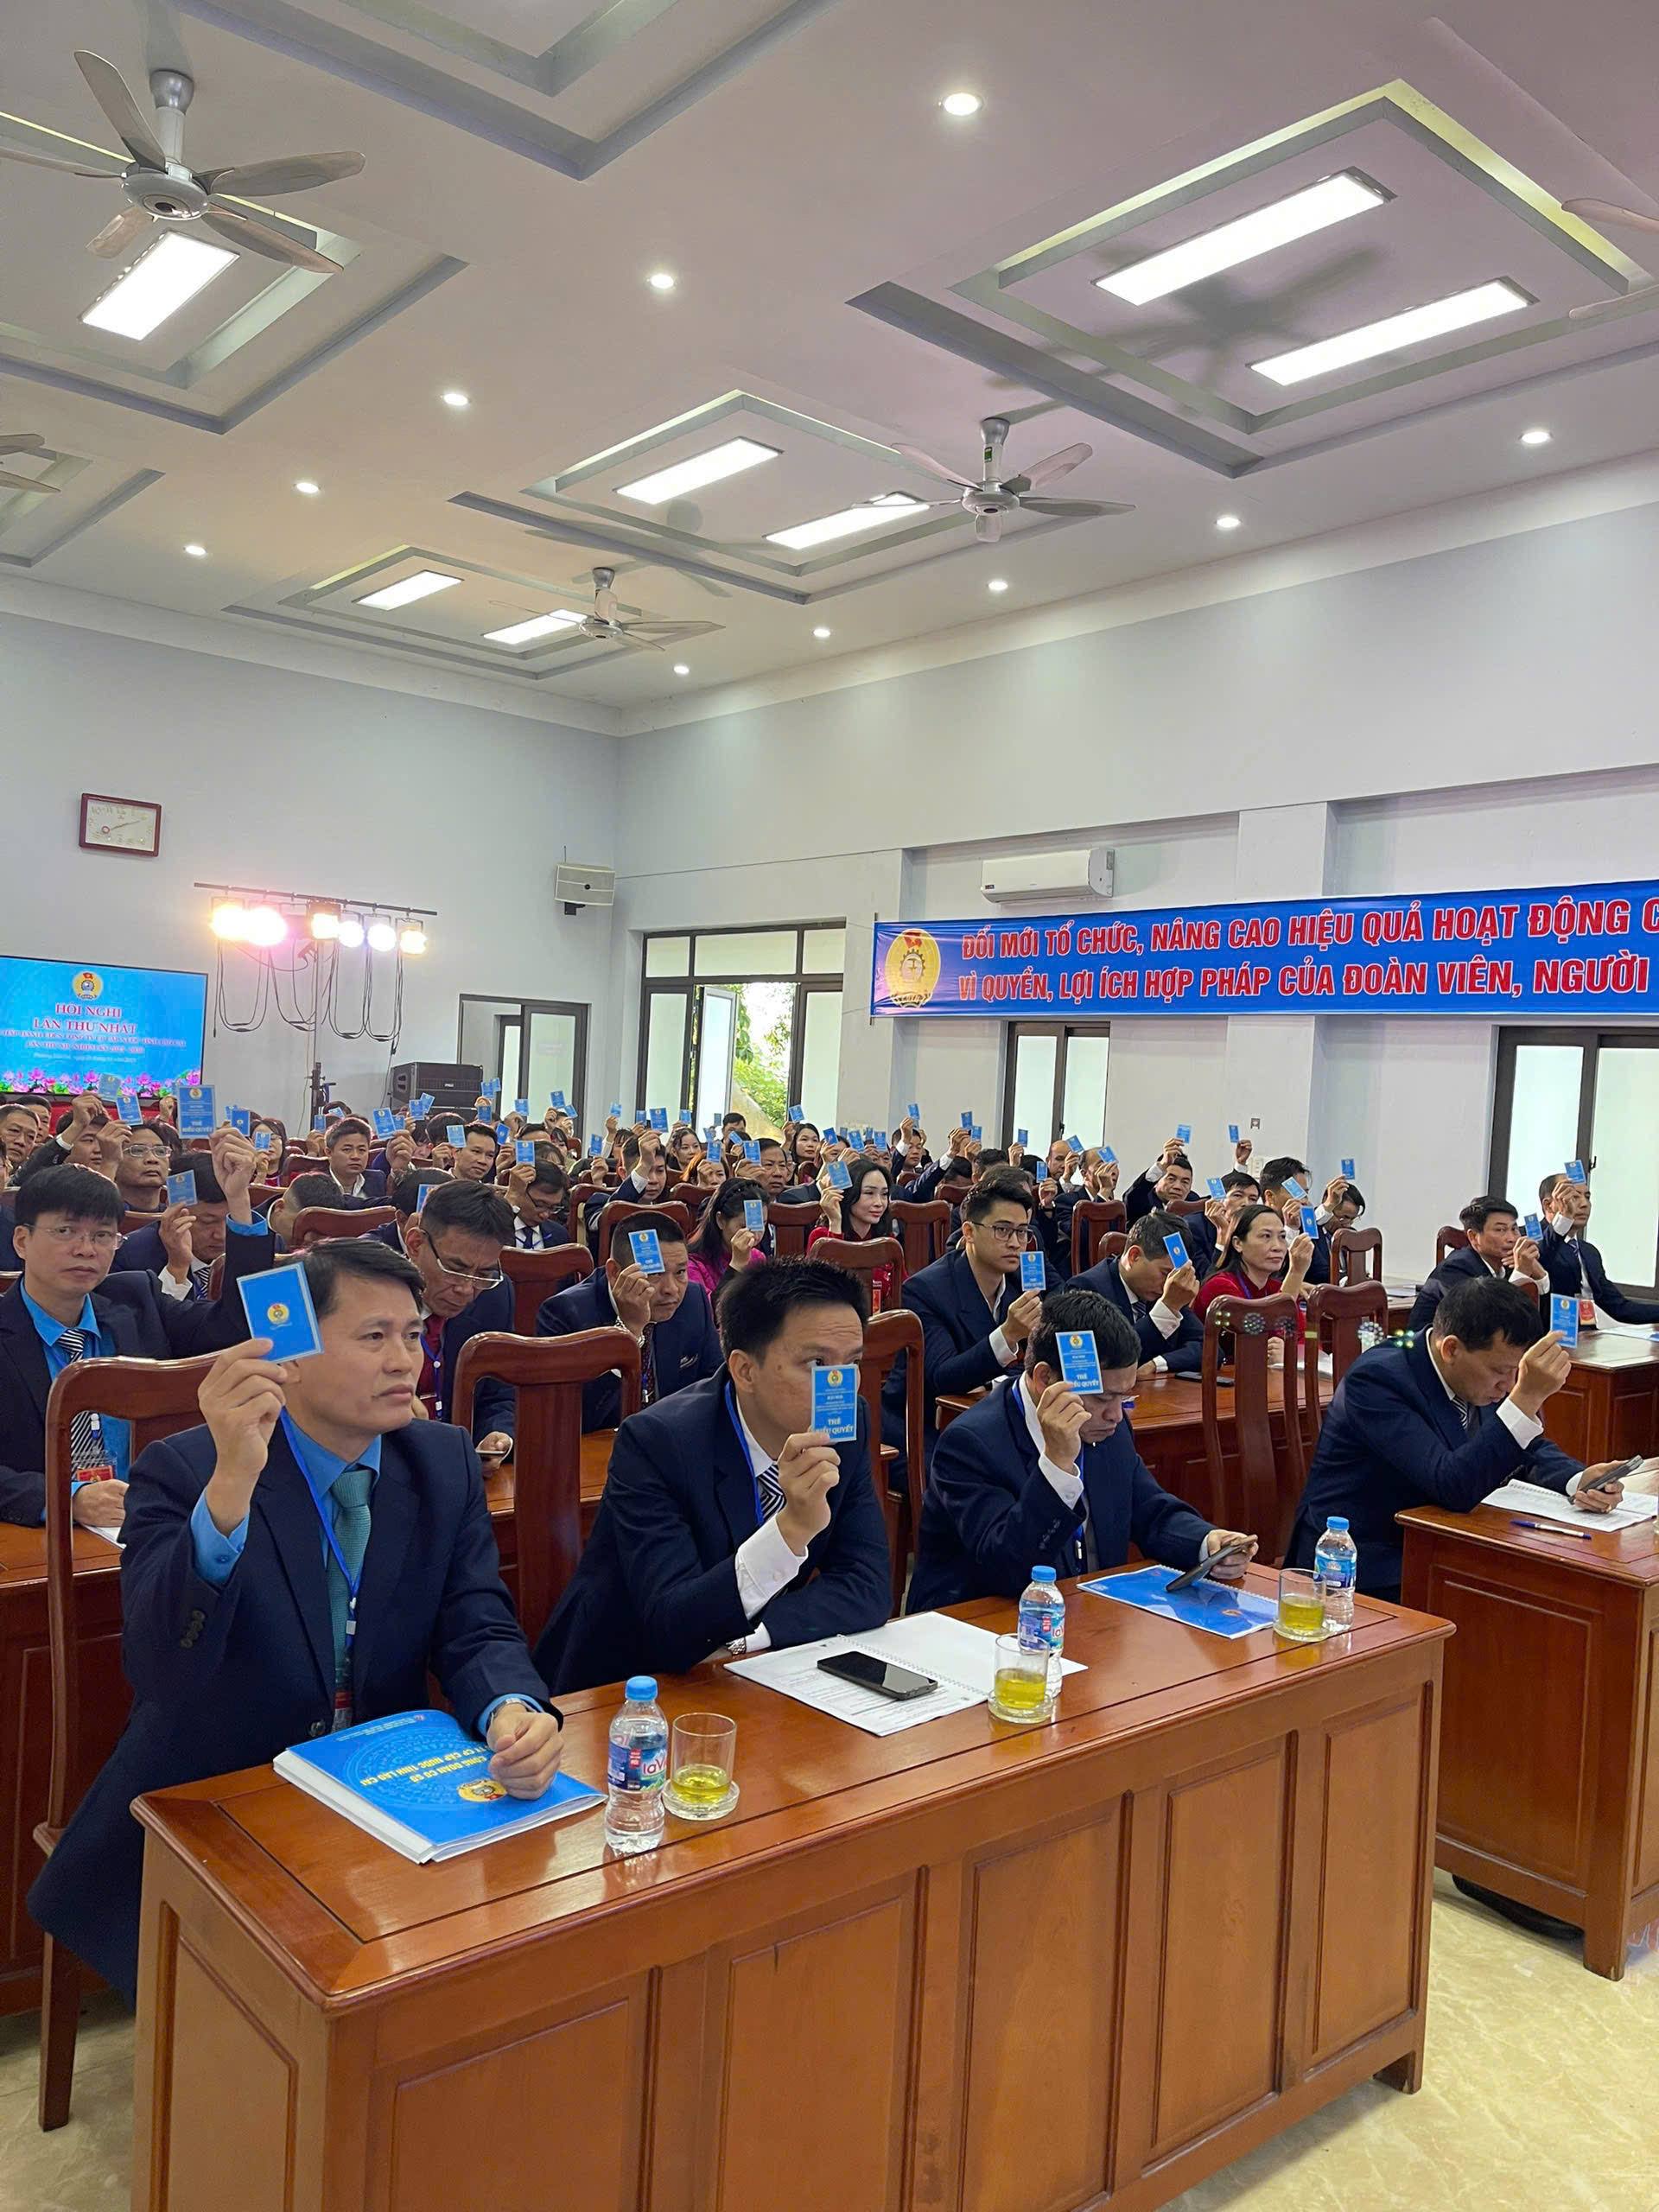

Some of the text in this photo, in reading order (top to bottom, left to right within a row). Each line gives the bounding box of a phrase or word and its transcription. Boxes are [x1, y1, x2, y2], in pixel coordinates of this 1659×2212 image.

[962, 925, 995, 960] ĐỔI
[1000, 926, 1039, 958] MỚI
[1046, 919, 1074, 956] TỔ
[1077, 921, 1143, 956] CHỨC,
[1151, 918, 1220, 952] NÂNG
[1228, 917, 1281, 948] CAO
[1287, 908, 1355, 951] HIỆU
[1362, 900, 1424, 947] QUẢ
[1433, 905, 1520, 945] HOẠT
[1528, 896, 1630, 944] ĐỘNG
[958, 950, 1649, 1004] VÌ QUYỀN, LỢI ÍCH HỢP PHÁP CỦA ĐOÀN VIÊN, NGƯỜI
